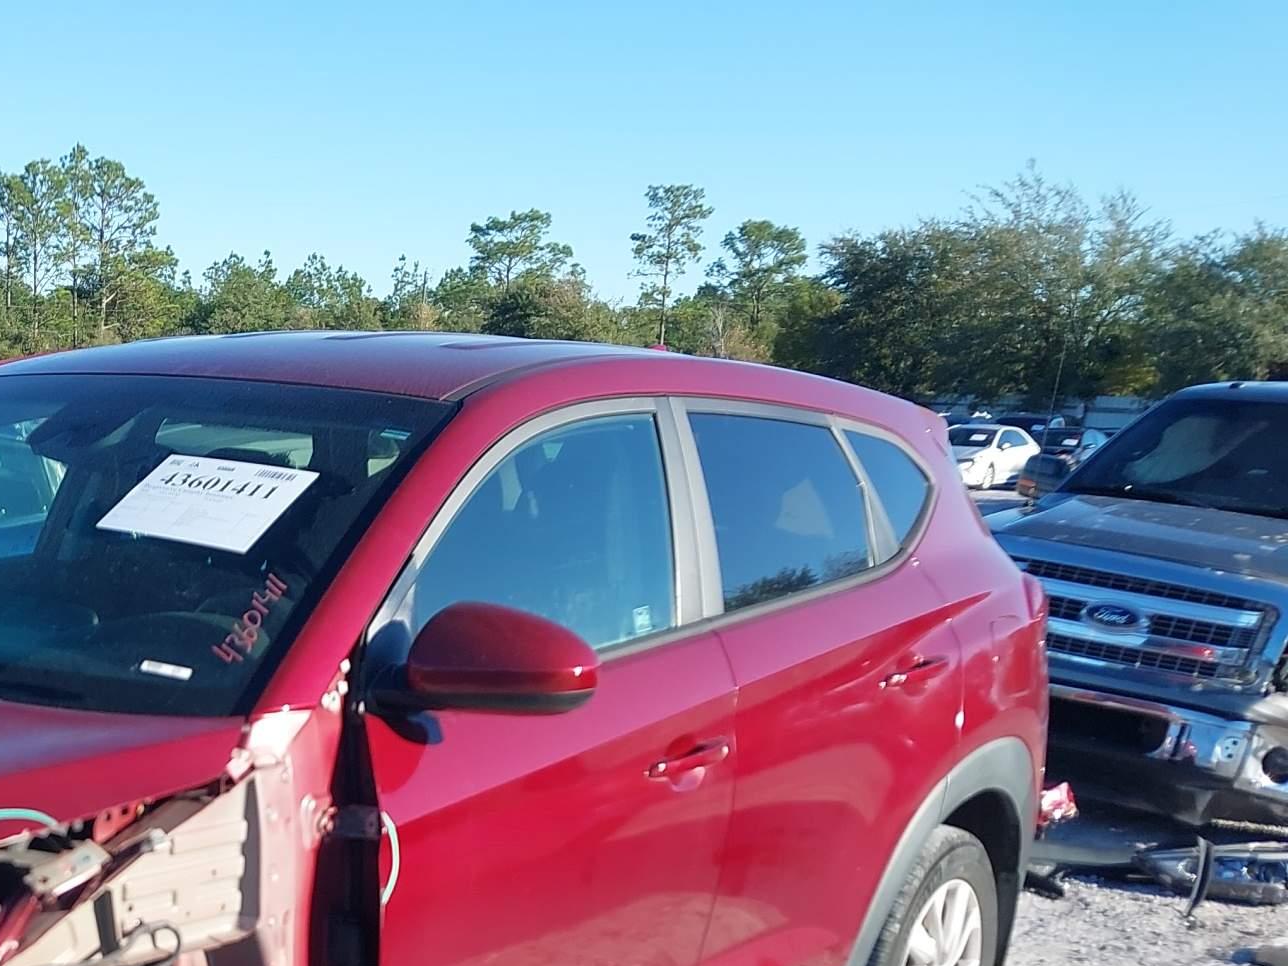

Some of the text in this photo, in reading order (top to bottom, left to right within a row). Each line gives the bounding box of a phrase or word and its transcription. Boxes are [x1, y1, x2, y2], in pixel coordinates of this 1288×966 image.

[160, 471, 279, 500] 43601411
[211, 572, 288, 664] 43601411
[1093, 606, 1131, 624] Ford
